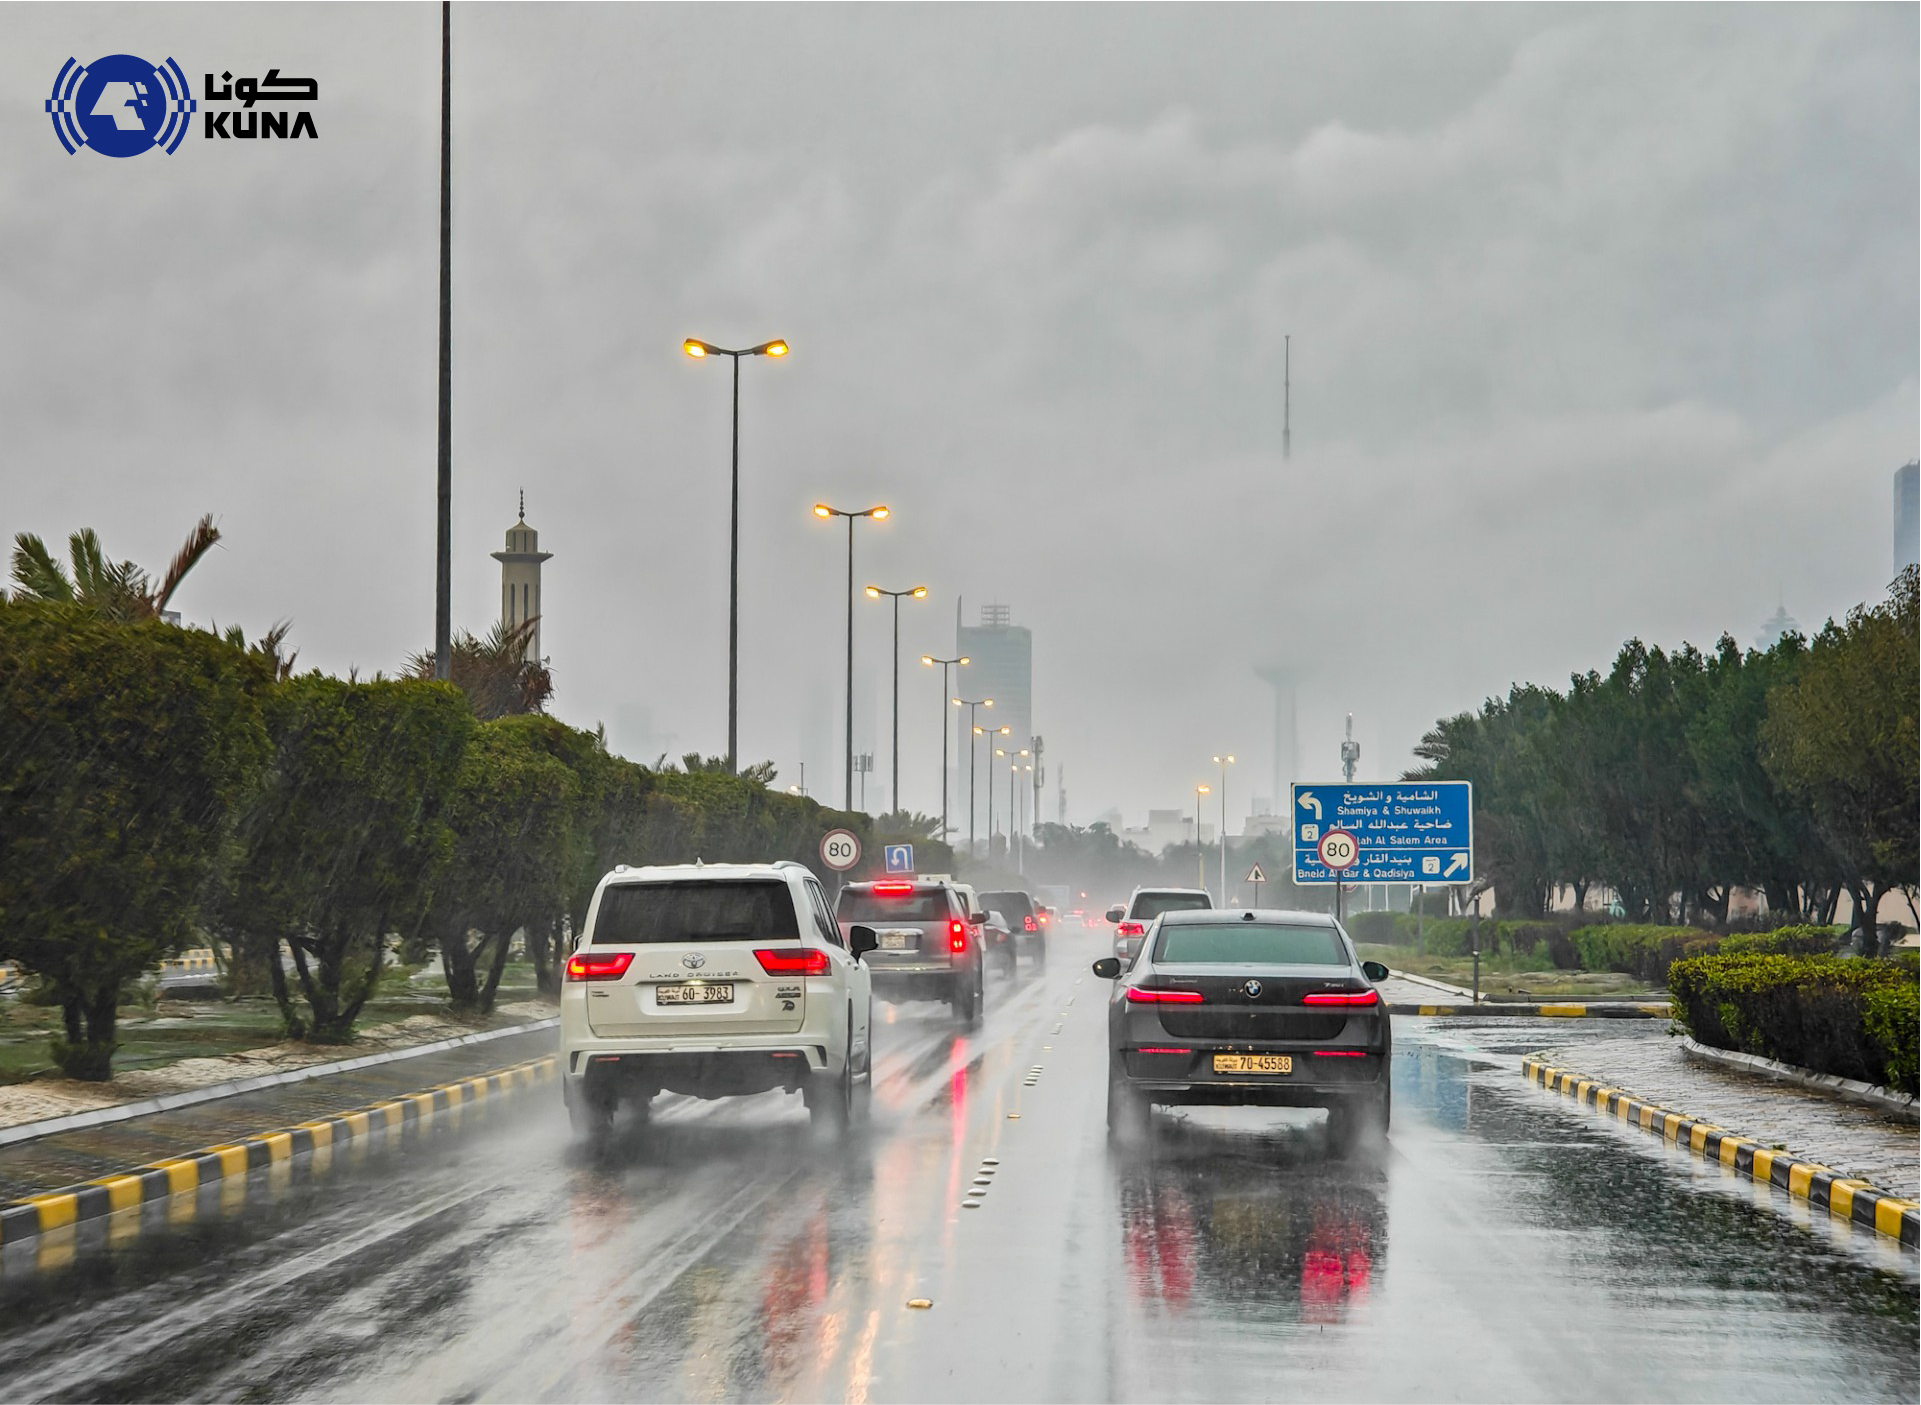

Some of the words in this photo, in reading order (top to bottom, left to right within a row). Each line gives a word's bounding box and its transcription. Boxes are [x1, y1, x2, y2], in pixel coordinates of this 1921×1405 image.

[1343, 790, 1383, 805] الشويخ
[1396, 790, 1438, 803] الشامية
[1337, 806, 1378, 817] Shamiya
[1382, 806, 1390, 815] &
[1394, 805, 1441, 815] Shuwaikh
[1413, 818, 1453, 831] ضاحية
[1306, 830, 1313, 840] 2
[1375, 835, 1386, 845] Al
[1389, 835, 1420, 845] Salem
[1424, 835, 1448, 845] Area
[829, 842, 851, 857] 80
[1326, 842, 1350, 858] 80
[1362, 853, 1388, 866] القار
[1427, 862, 1434, 872] 2
[1297, 869, 1325, 878] Bneid
[1342, 869, 1360, 878] Gar
[1363, 869, 1370, 878] &
[1373, 869, 1415, 880] Qadisiya
[1240, 1057, 1290, 1070] 70-45588
